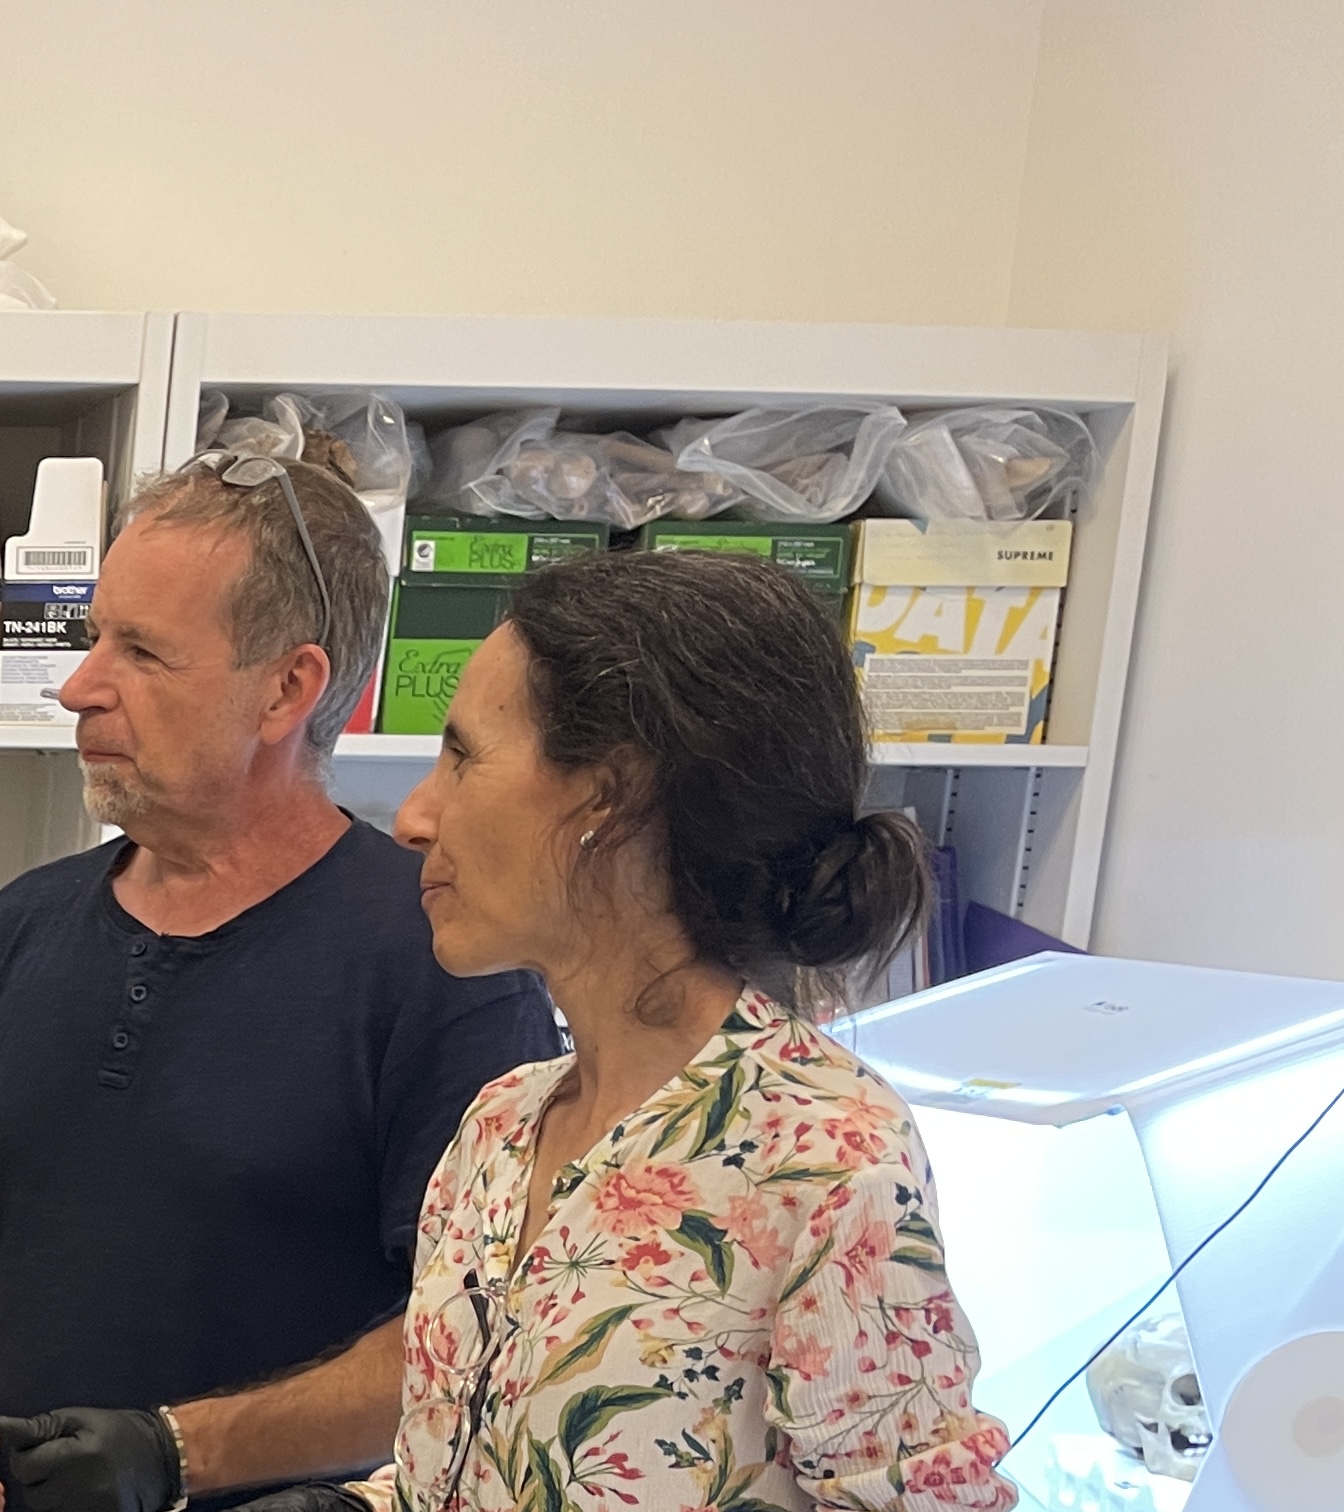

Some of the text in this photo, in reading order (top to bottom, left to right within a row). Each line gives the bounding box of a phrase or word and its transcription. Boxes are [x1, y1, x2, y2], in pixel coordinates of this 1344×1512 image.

[468, 553, 515, 570] PLUS
[997, 550, 1054, 561] SUPREME
[2, 620, 67, 635] TN-241BK
